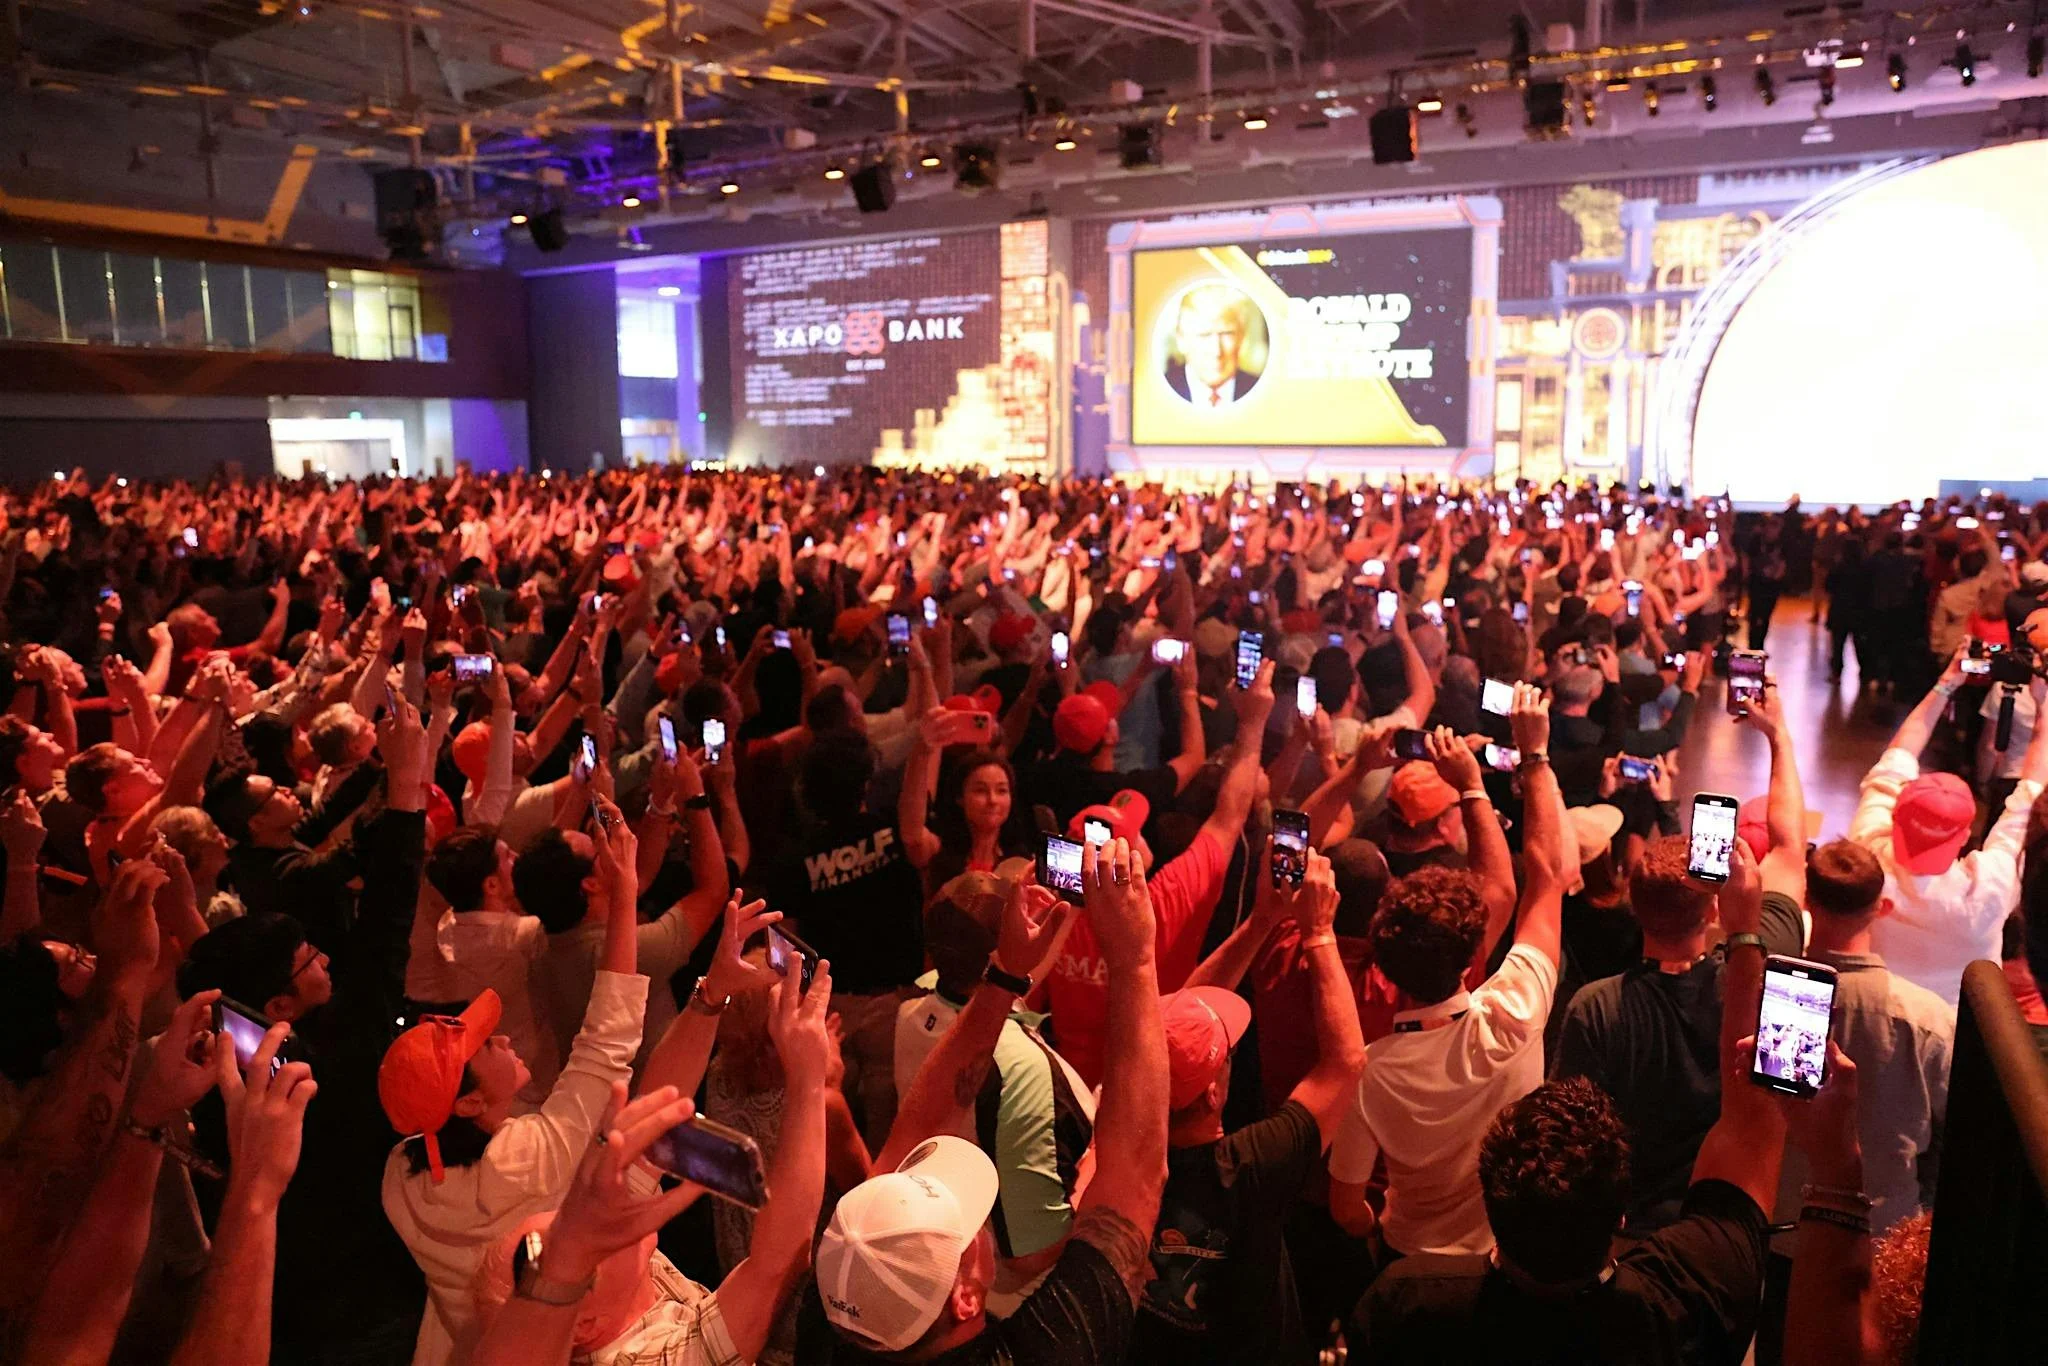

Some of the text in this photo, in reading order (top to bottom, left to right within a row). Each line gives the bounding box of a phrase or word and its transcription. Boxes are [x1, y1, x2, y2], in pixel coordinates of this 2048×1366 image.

[773, 323, 843, 349] XAPO
[888, 316, 964, 343] BANK
[804, 827, 894, 881] WOLF
